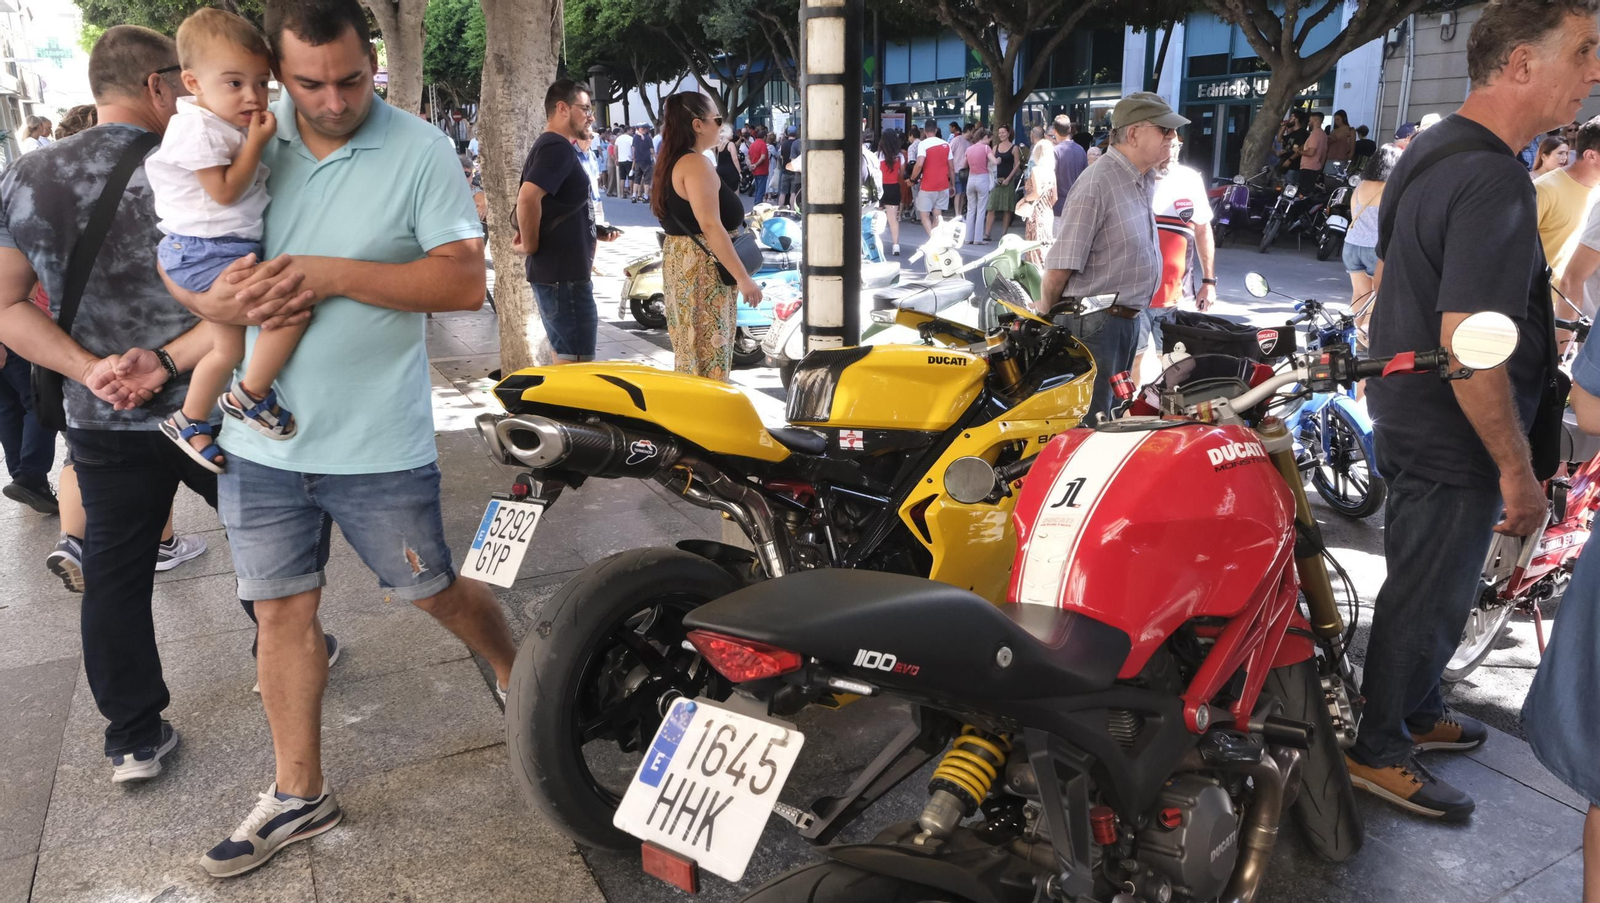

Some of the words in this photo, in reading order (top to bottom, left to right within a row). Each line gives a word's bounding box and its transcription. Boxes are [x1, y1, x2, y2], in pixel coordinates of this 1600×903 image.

[1198, 80, 1250, 98] Edificio
[927, 355, 967, 367] DUCATI
[1206, 442, 1266, 466] DUCATI
[1214, 457, 1270, 473] MONSTER
[489, 506, 536, 543] 5292
[478, 530, 485, 541] E
[475, 541, 511, 576] GYP
[893, 662, 920, 676] EVO
[650, 752, 665, 771] E
[686, 718, 788, 795] 1645
[646, 772, 734, 852] HHK
[1210, 830, 1236, 863] DUCATI
